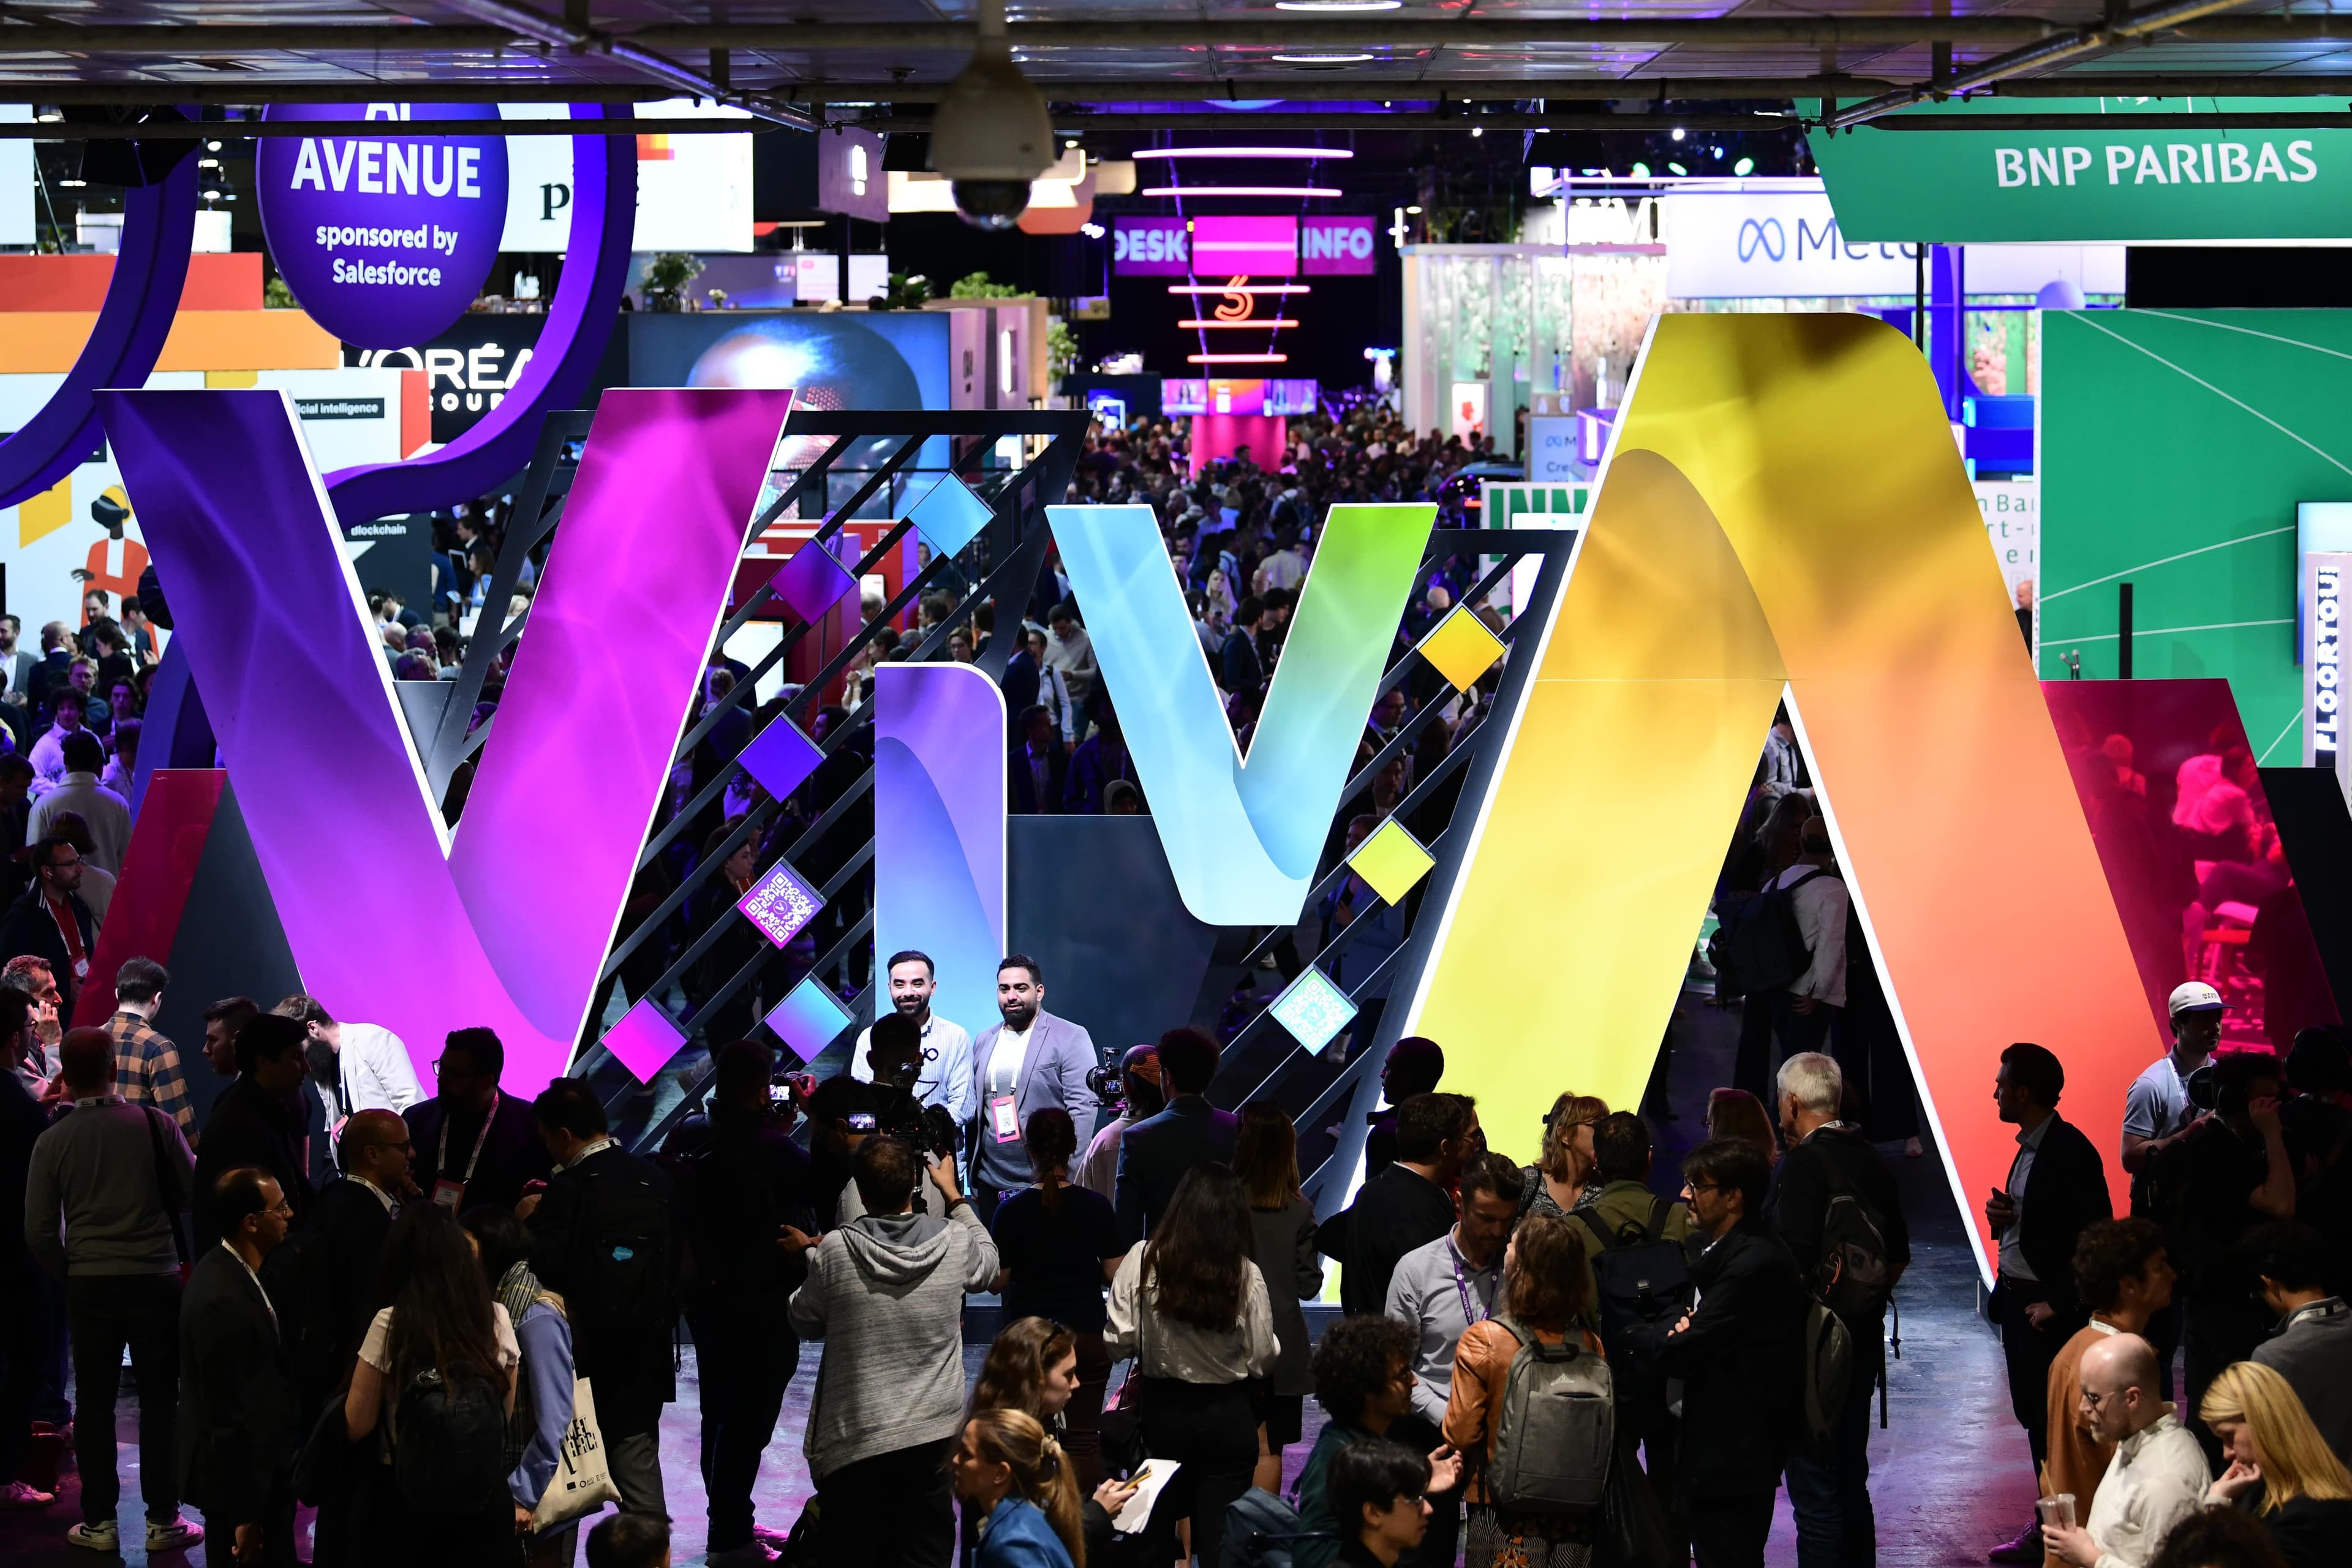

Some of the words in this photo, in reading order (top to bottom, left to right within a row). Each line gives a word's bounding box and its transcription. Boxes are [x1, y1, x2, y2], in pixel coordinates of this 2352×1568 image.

[290, 137, 481, 198] AVENUE
[1994, 146, 2092, 187] BNP
[2105, 140, 2318, 185] PARIBAS
[316, 224, 428, 251] sponsored
[433, 225, 459, 255] by
[333, 258, 442, 287] Salesforce
[320, 402, 379, 416] intelligence
